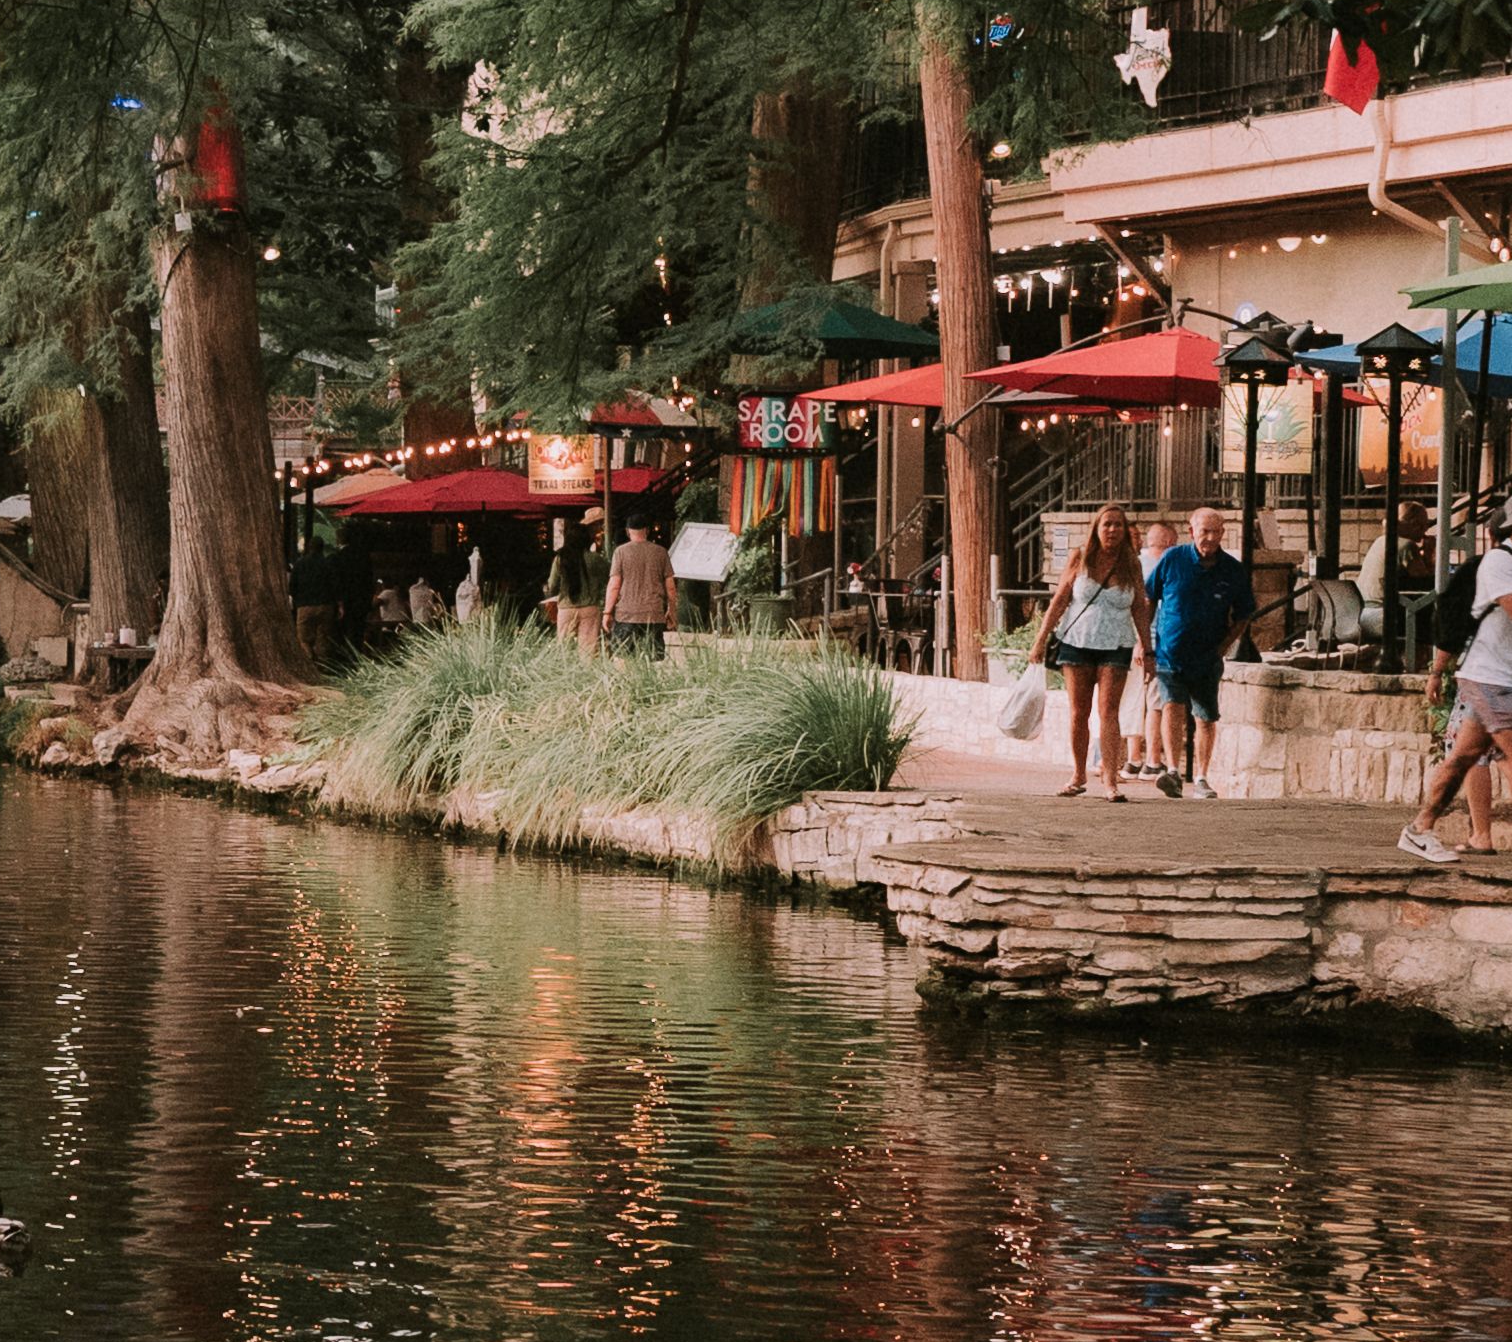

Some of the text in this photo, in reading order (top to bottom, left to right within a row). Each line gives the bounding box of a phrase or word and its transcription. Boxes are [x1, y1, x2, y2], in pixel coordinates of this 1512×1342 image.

[738, 400, 837, 423] SARAPE
[749, 423, 825, 443] ROOM
[532, 479, 593, 490] TEXAS STEAKS
